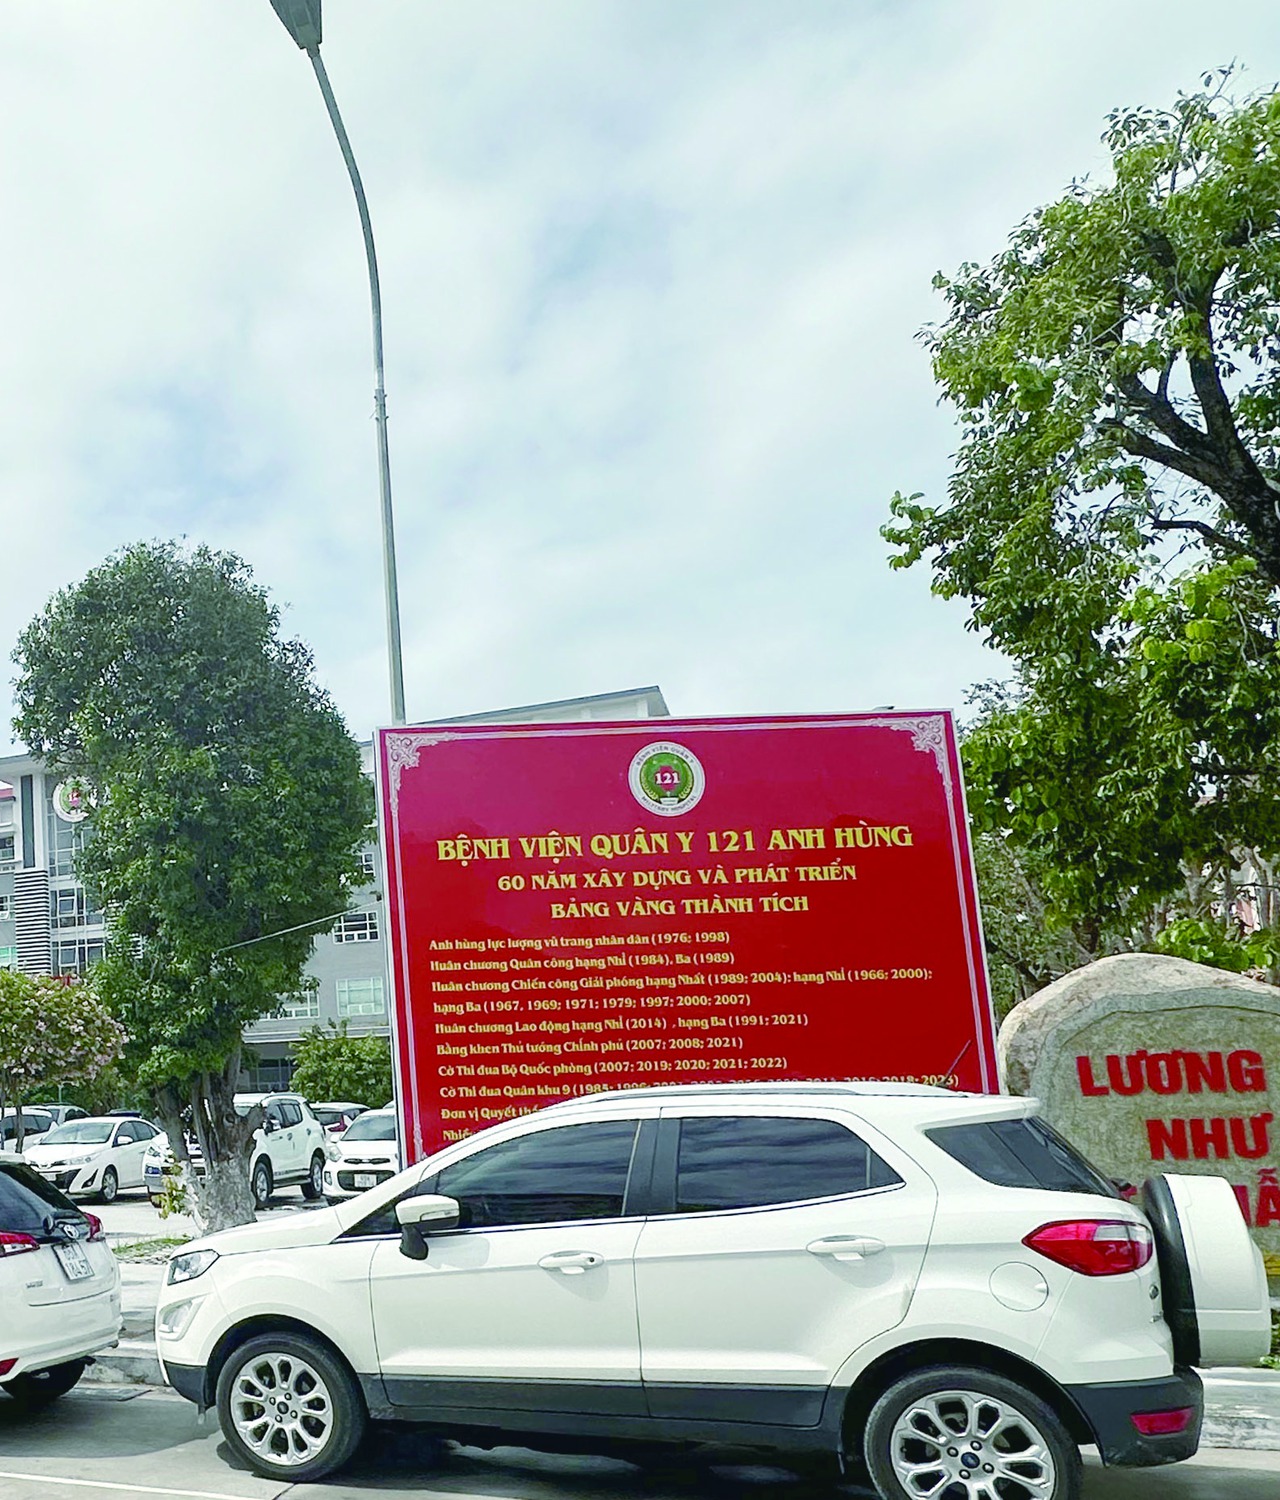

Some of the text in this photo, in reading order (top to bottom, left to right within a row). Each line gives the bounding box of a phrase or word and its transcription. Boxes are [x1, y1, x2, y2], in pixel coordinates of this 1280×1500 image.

[655, 772, 681, 785] 121
[436, 821, 914, 867] BỆNH VIỆN QUÂN Y 121 ANH HÙNG
[497, 857, 857, 891] 60 NĂM XÂY DỰNG VÀ PHÁT TRIỂN
[550, 891, 809, 919] BẢNG VÀNG THÀNH TÍCH
[429, 939, 454, 951] Anh
[454, 938, 487, 952] hùng
[487, 938, 506, 952] lực
[507, 938, 543, 951] lượng
[559, 936, 594, 949] trang
[594, 934, 625, 946] nhân
[626, 934, 650, 945] dân
[695, 931, 730, 944] 1998)
[430, 960, 462, 971] Huân
[462, 959, 509, 973] chương
[509, 958, 542, 971] Quân
[543, 957, 575, 971] công
[574, 956, 607, 970] hạng
[674, 953, 692, 964] Ba
[692, 952, 735, 966] (1989)
[431, 981, 464, 992] Huân
[464, 980, 511, 993] chương
[510, 977, 547, 990] Chiến
[547, 978, 579, 992] công
[579, 976, 604, 988] Giải
[605, 976, 645, 990] phóng
[645, 975, 677, 989] hạng
[677, 972, 705, 985] Nhất
[792, 971, 825, 985] hạng
[433, 1002, 465, 1016] hạng
[465, 1001, 482, 1012] Ba
[713, 994, 751, 1006] 2007)
[435, 1023, 467, 1034] Huân
[468, 1022, 514, 1036] chương
[514, 1021, 538, 1032] Lao
[538, 1020, 571, 1034] động
[571, 1020, 603, 1033] hạng
[625, 1017, 667, 1031] (2014)
[677, 1017, 710, 1030] hạng
[710, 1016, 727, 1027] Ba
[771, 1013, 809, 1026] 2021)
[436, 1042, 469, 1058] Bằng
[500, 1040, 525, 1054] Thủ
[525, 1041, 563, 1056] tướng
[600, 1038, 624, 1054] phủ
[706, 1037, 743, 1049] 2021)
[437, 1065, 455, 1077] Cờ
[455, 1064, 476, 1076] Thi
[476, 1064, 500, 1076] đua
[501, 1064, 518, 1078] Bộ
[519, 1061, 551, 1076] Quốc
[552, 1062, 593, 1077] phòng
[750, 1057, 788, 1069] 2022)
[1075, 1049, 1267, 1097] LƯƠNG
[439, 1086, 457, 1098] Cờ
[457, 1085, 477, 1098] Thi
[478, 1085, 502, 1097] đua
[502, 1085, 536, 1098] Quân
[536, 1084, 561, 1096] khu
[561, 1084, 571, 1095] 9
[440, 1108, 467, 1119] Đơn
[467, 1107, 479, 1122] vị
[480, 1104, 518, 1122] Quyết
[1145, 1112, 1275, 1161] NHƯ
